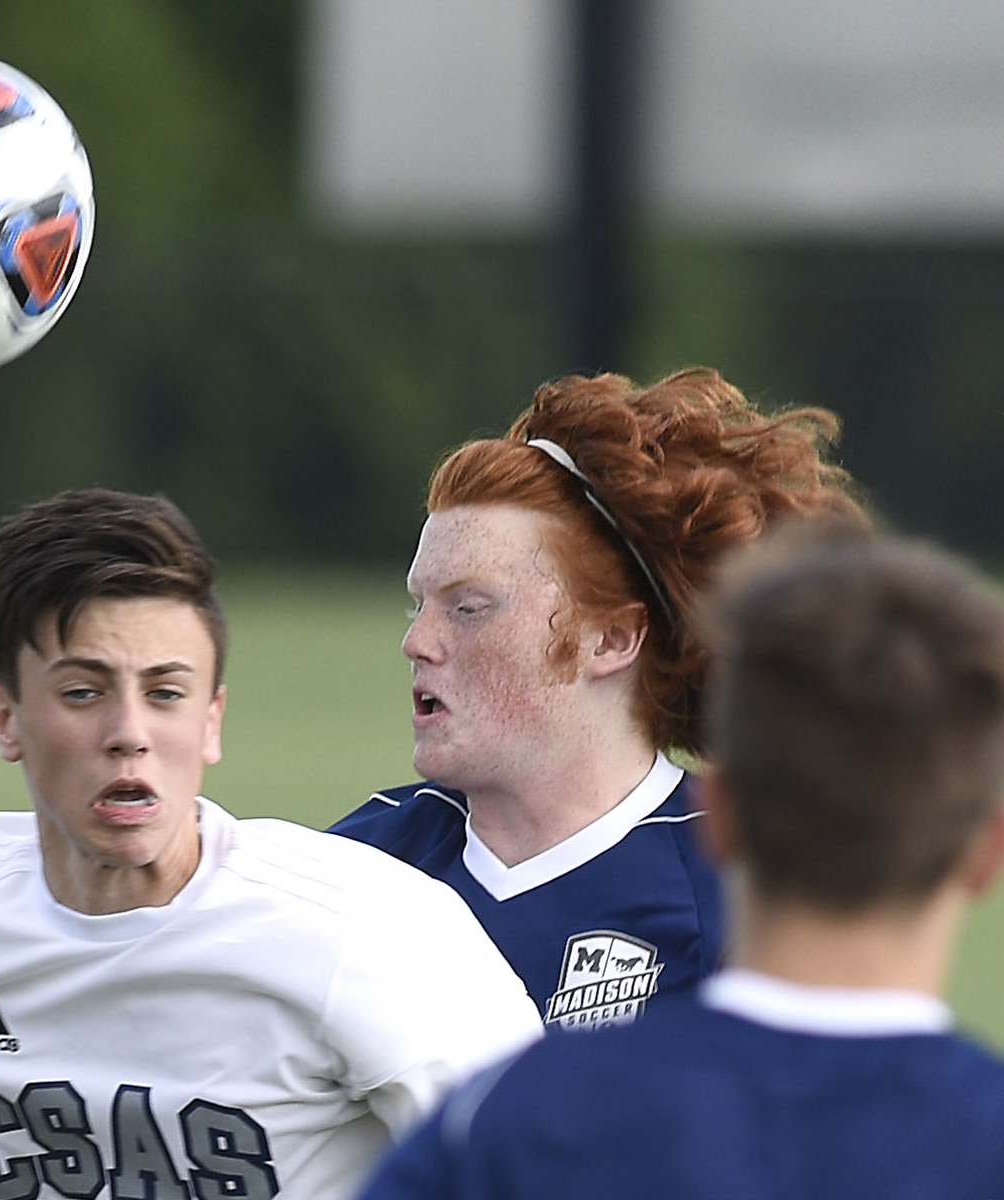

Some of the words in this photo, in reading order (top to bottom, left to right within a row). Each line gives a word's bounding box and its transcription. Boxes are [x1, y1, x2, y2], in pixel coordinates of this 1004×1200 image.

[573, 947, 605, 972] M
[553, 973, 652, 1016] MADISON
[567, 1004, 633, 1027] SOCCER
